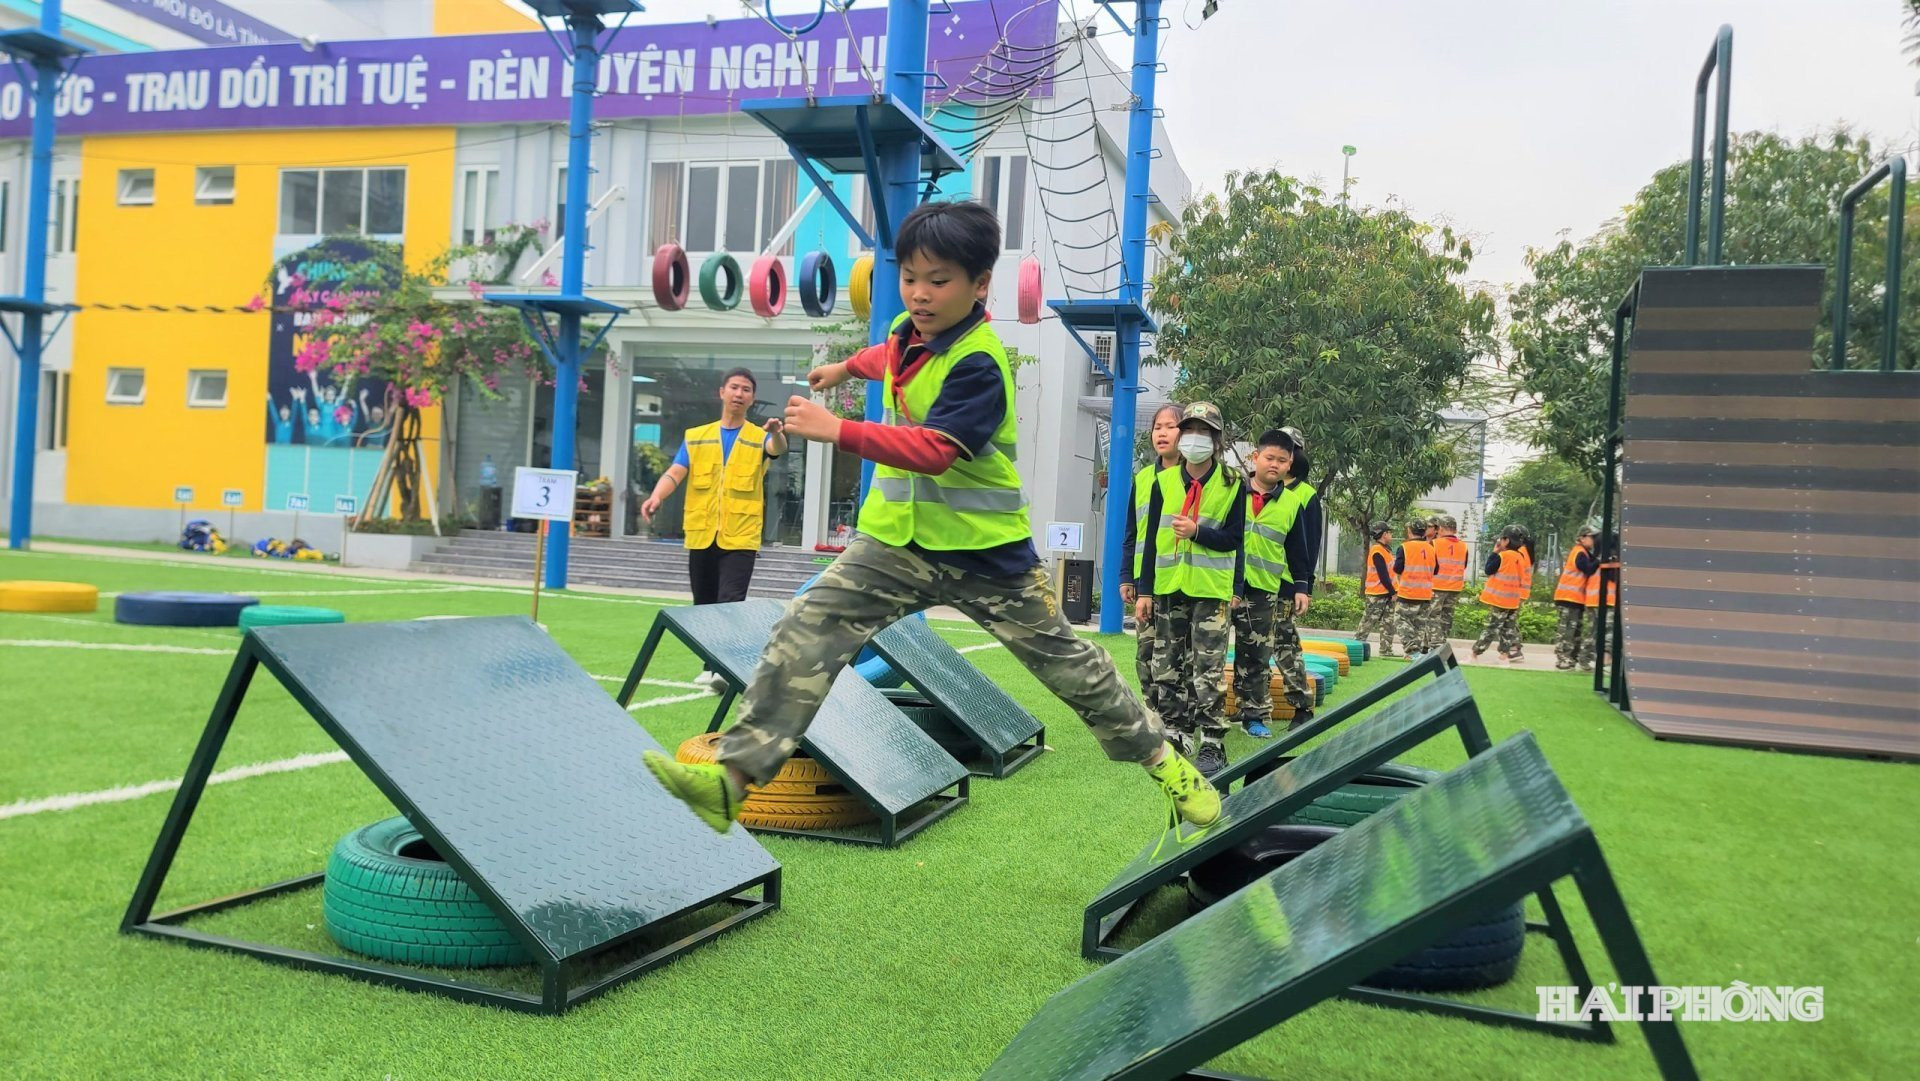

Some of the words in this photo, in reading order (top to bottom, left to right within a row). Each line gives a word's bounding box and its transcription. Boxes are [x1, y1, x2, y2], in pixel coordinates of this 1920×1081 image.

[0, 81, 22, 120] O
[102, 91, 117, 102] -
[126, 69, 210, 112] TRAU
[289, 56, 347, 107] TRÍ
[358, 54, 428, 110] TUỆ
[440, 79, 456, 89] -
[467, 49, 549, 101] RÈN
[536, 486, 551, 507] 3
[1060, 532, 1067, 545] 2
[1421, 549, 1427, 560] 1
[1448, 545, 1454, 556] 1
